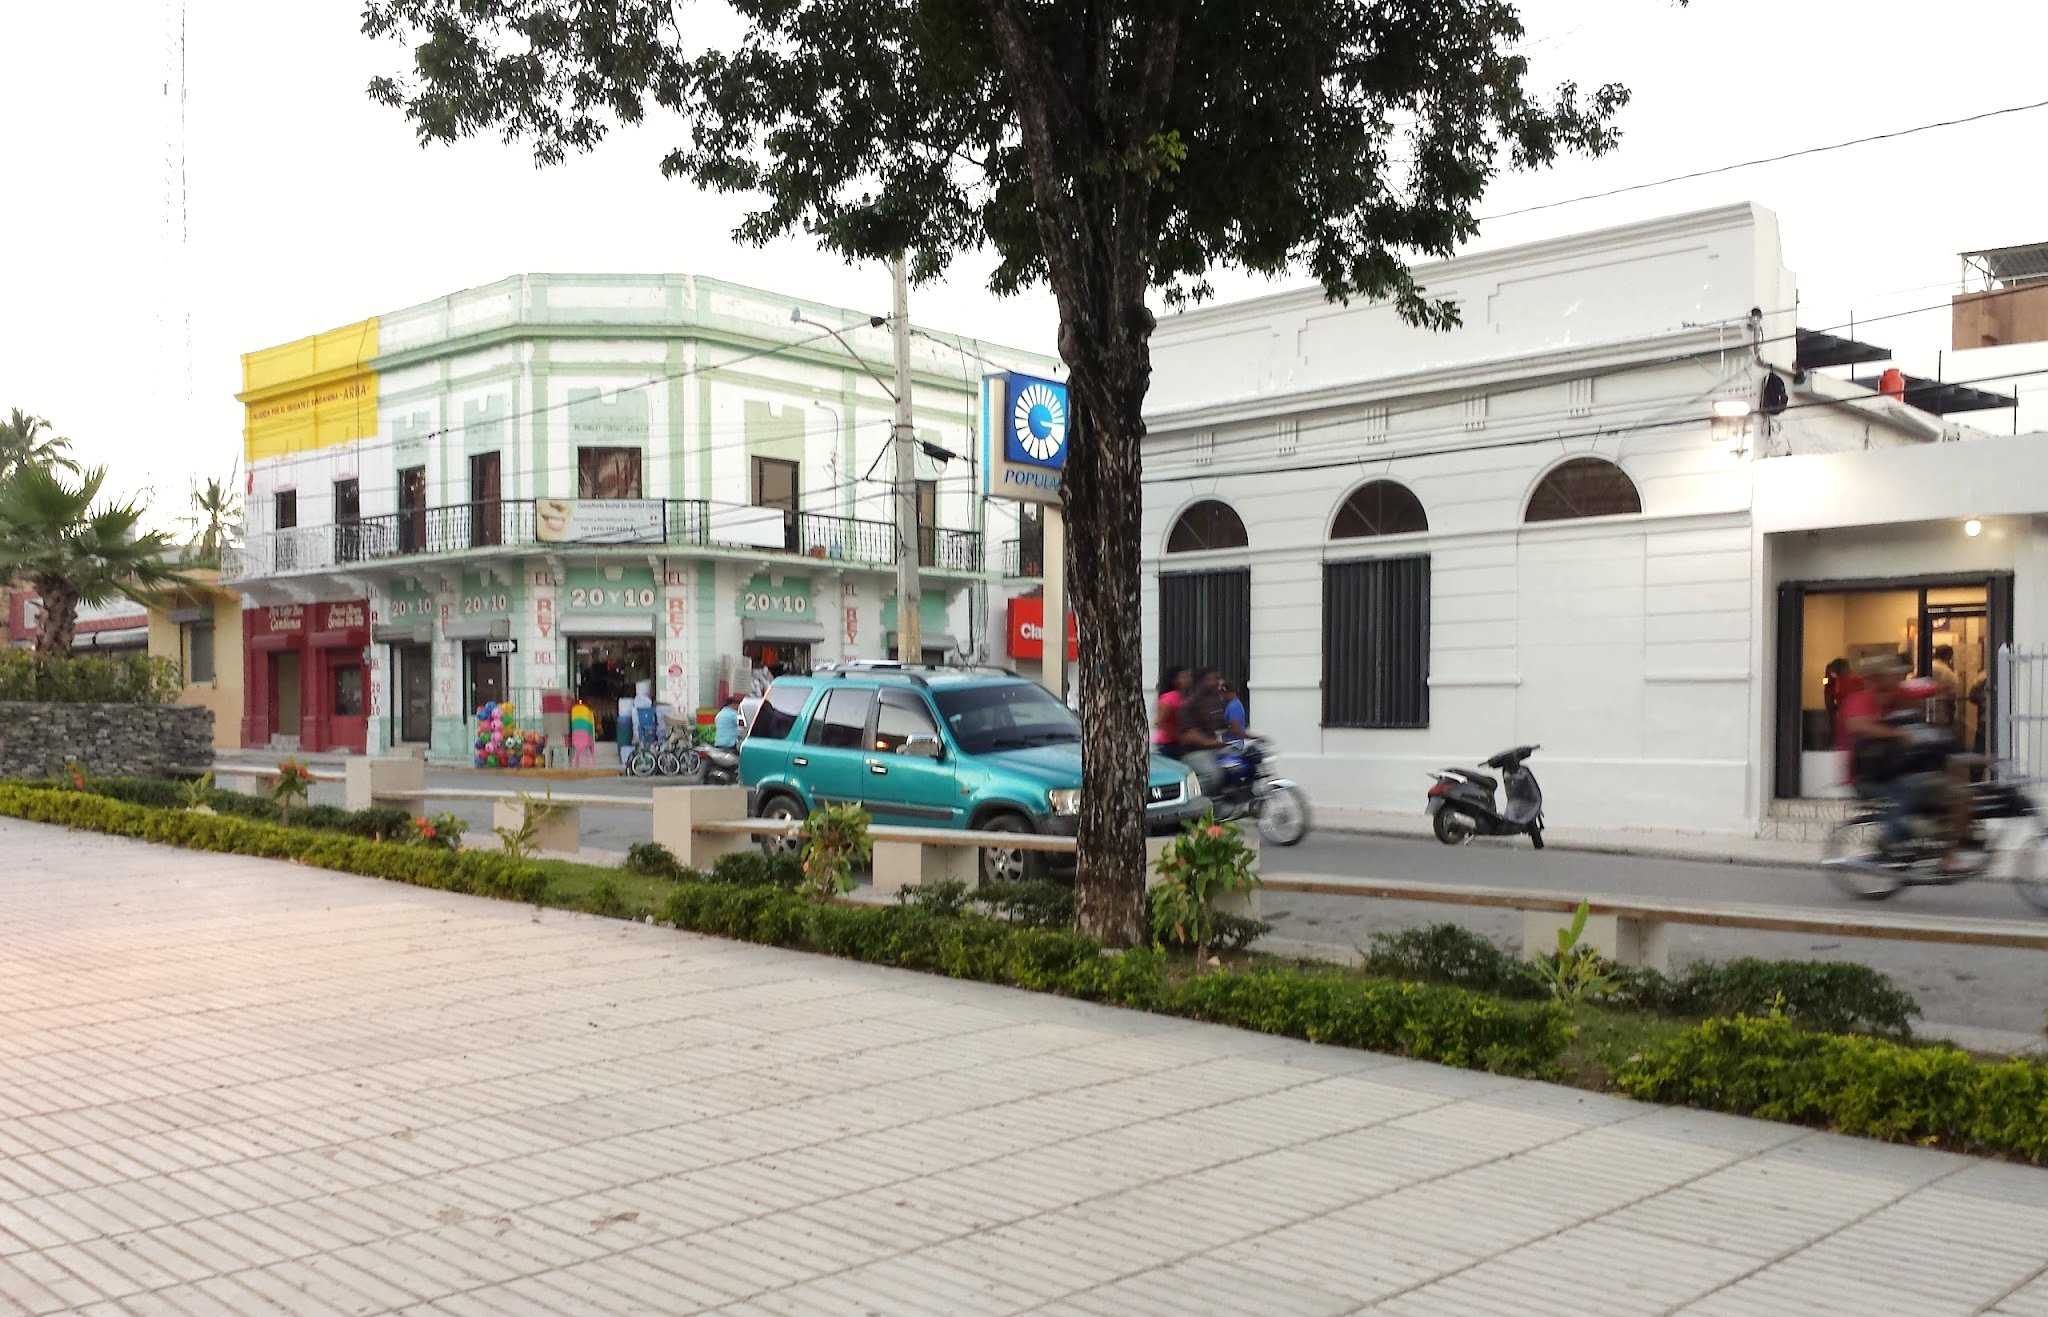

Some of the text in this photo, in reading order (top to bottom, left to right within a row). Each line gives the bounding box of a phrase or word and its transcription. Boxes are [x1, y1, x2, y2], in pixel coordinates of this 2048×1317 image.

[535, 572, 551, 585] EL
[669, 572, 685, 585] EL
[571, 588, 655, 608] 20 Y 10
[845, 584, 856, 596] EL
[392, 601, 407, 616] 20
[408, 604, 415, 612] Y
[418, 598, 432, 615] 10
[464, 594, 507, 614] 20 Y 10
[744, 593, 806, 613] 20 Y 10
[537, 599, 552, 638] REY
[669, 598, 684, 637] REY
[846, 607, 858, 645] REY
[1020, 622, 1043, 640] Cla
[535, 652, 551, 664] DEL
